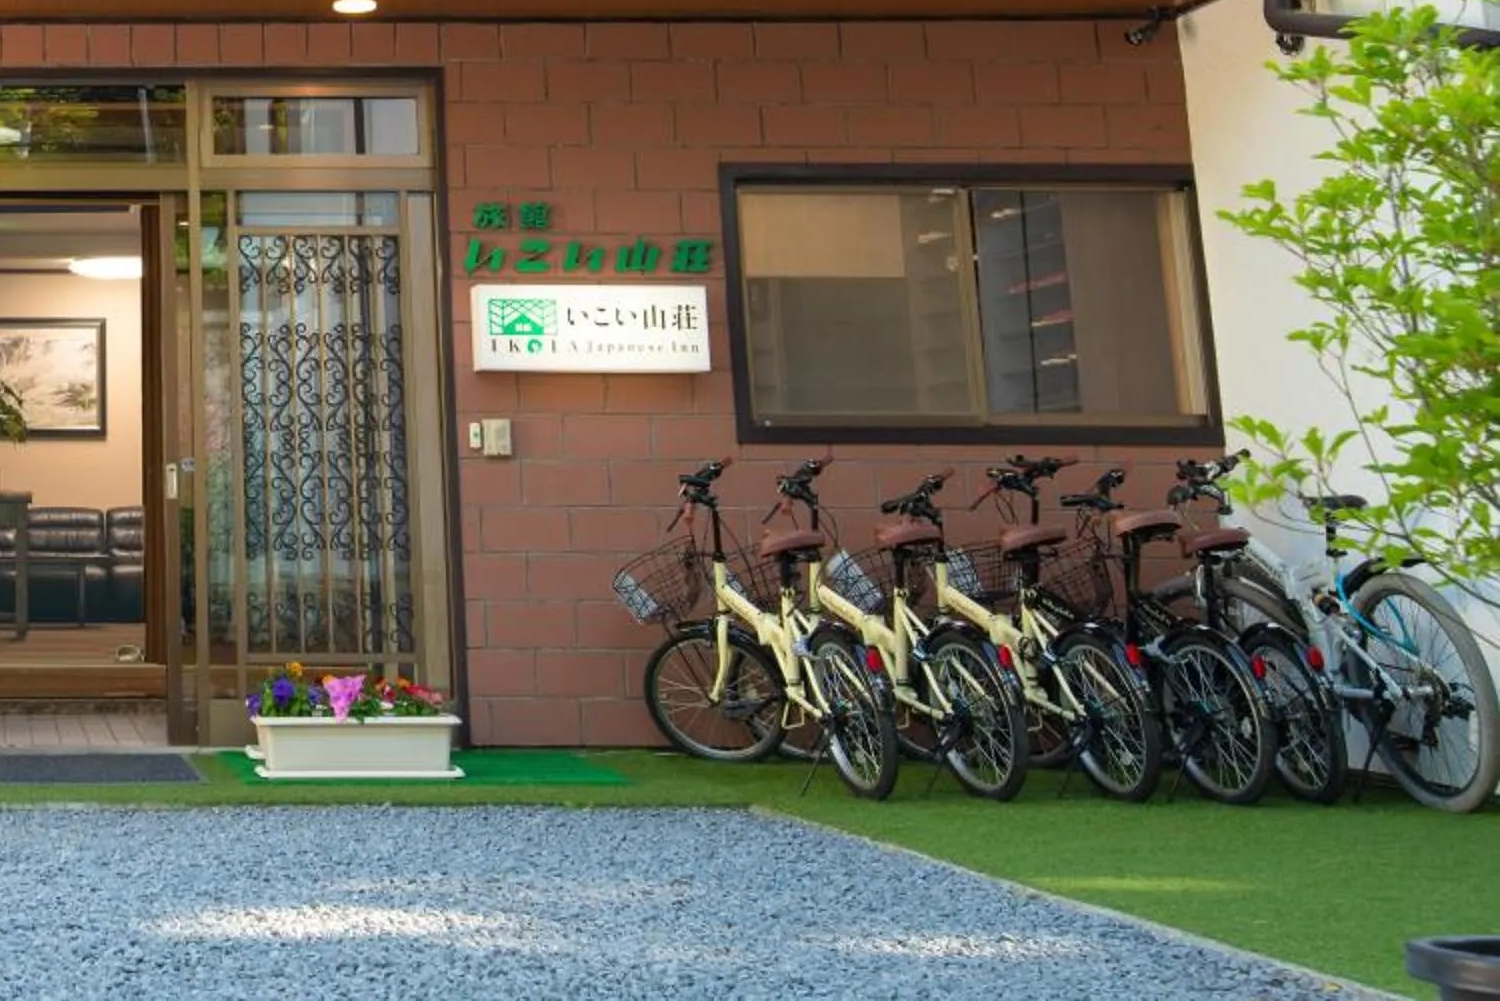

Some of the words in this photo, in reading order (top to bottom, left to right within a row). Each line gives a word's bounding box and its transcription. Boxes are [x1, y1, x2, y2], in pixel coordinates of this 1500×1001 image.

[566, 304, 699, 331] いこい山荘
